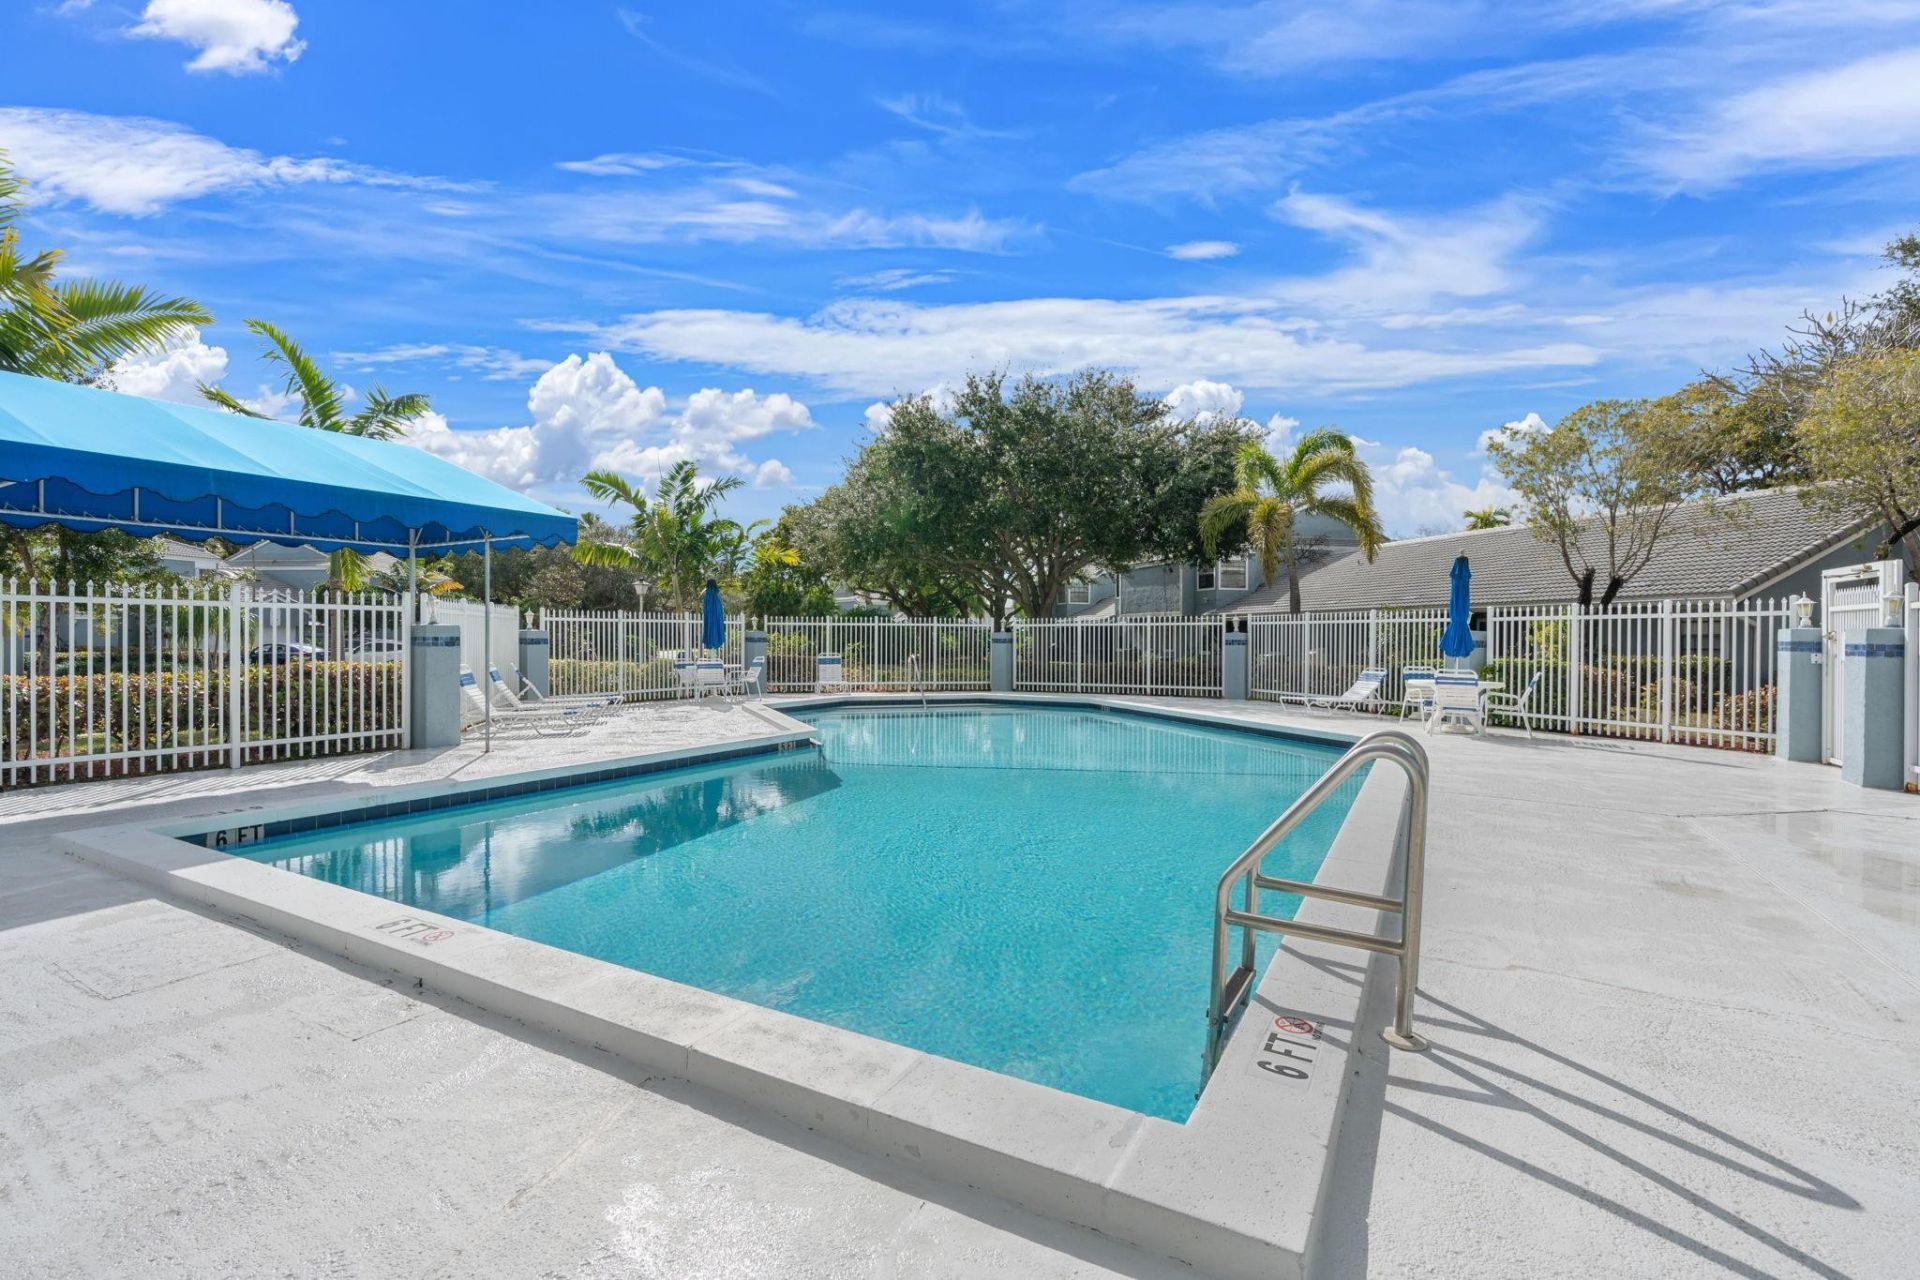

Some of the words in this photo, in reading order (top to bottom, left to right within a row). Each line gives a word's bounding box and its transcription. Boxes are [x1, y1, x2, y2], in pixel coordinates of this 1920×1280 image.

[238, 824, 263, 843] FT
[388, 923, 439, 938] FT
[1263, 1032, 1317, 1063] FT
[1257, 1061, 1309, 1080] 6
